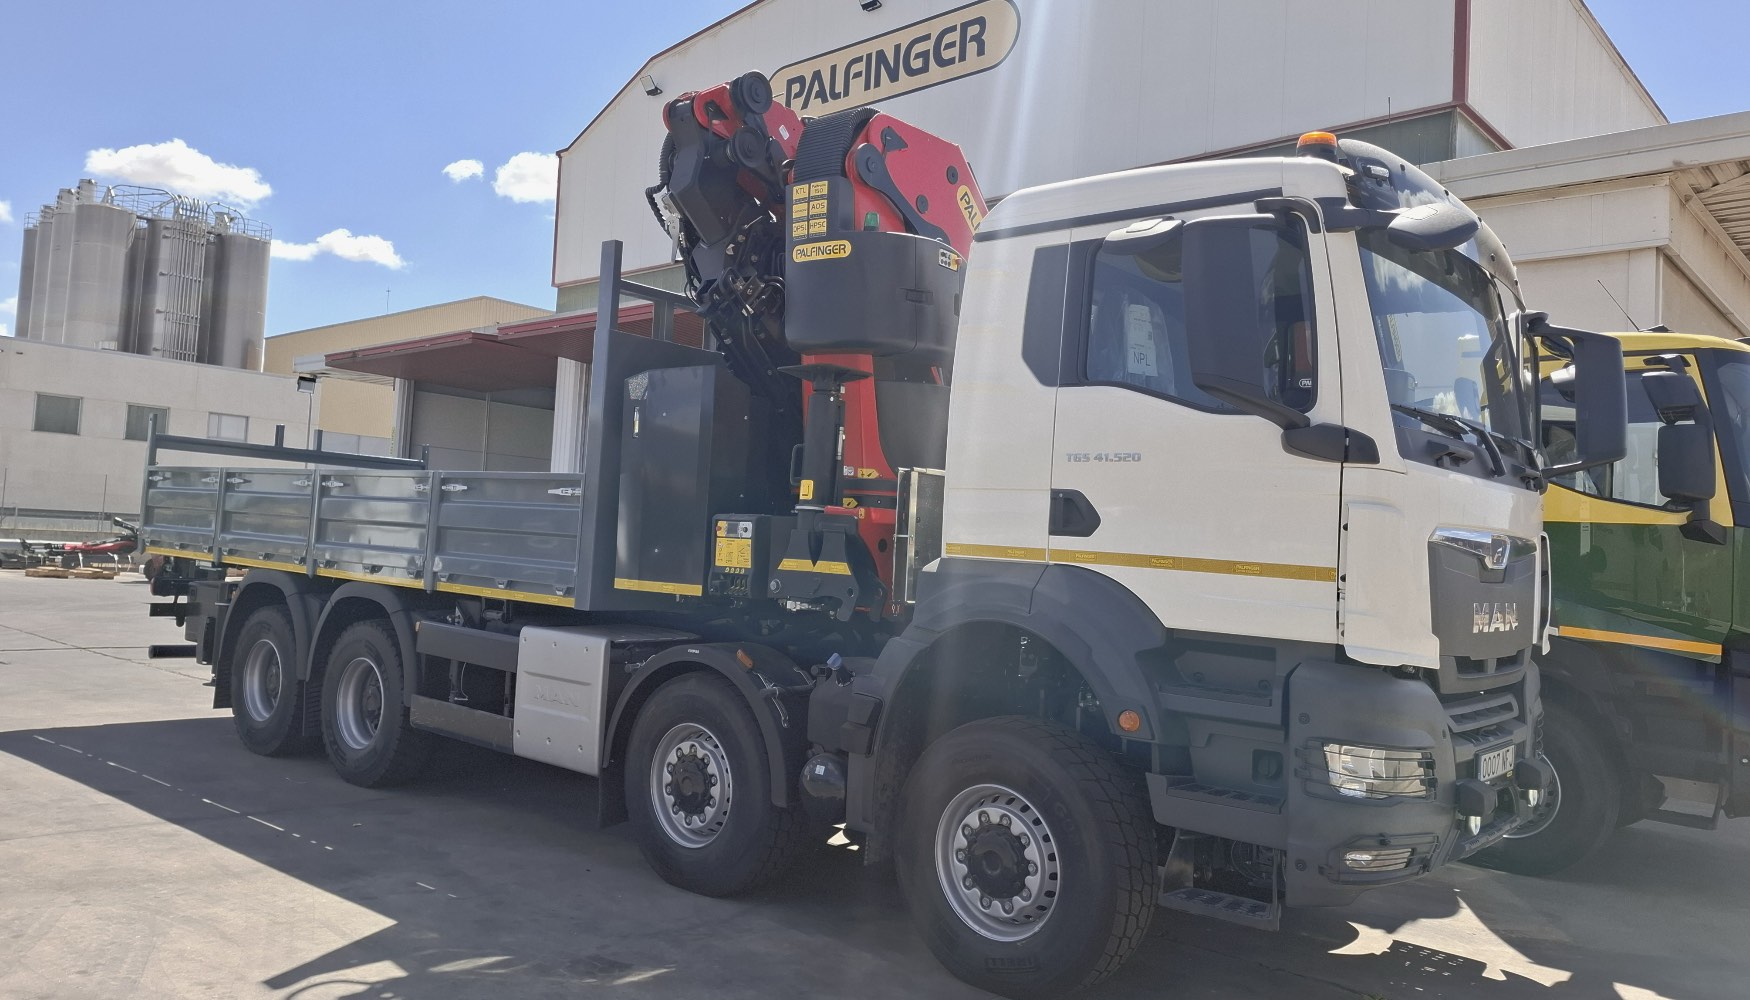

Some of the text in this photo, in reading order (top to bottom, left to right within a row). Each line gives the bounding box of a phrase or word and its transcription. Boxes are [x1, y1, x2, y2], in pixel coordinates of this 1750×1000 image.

[785, 15, 987, 110] PALFINGER
[795, 187, 806, 195] KTL
[811, 203, 826, 211] AOS
[795, 243, 847, 260] PALFINGER
[1066, 453, 1142, 463] TGS 41.520
[1472, 602, 1519, 634] MAN
